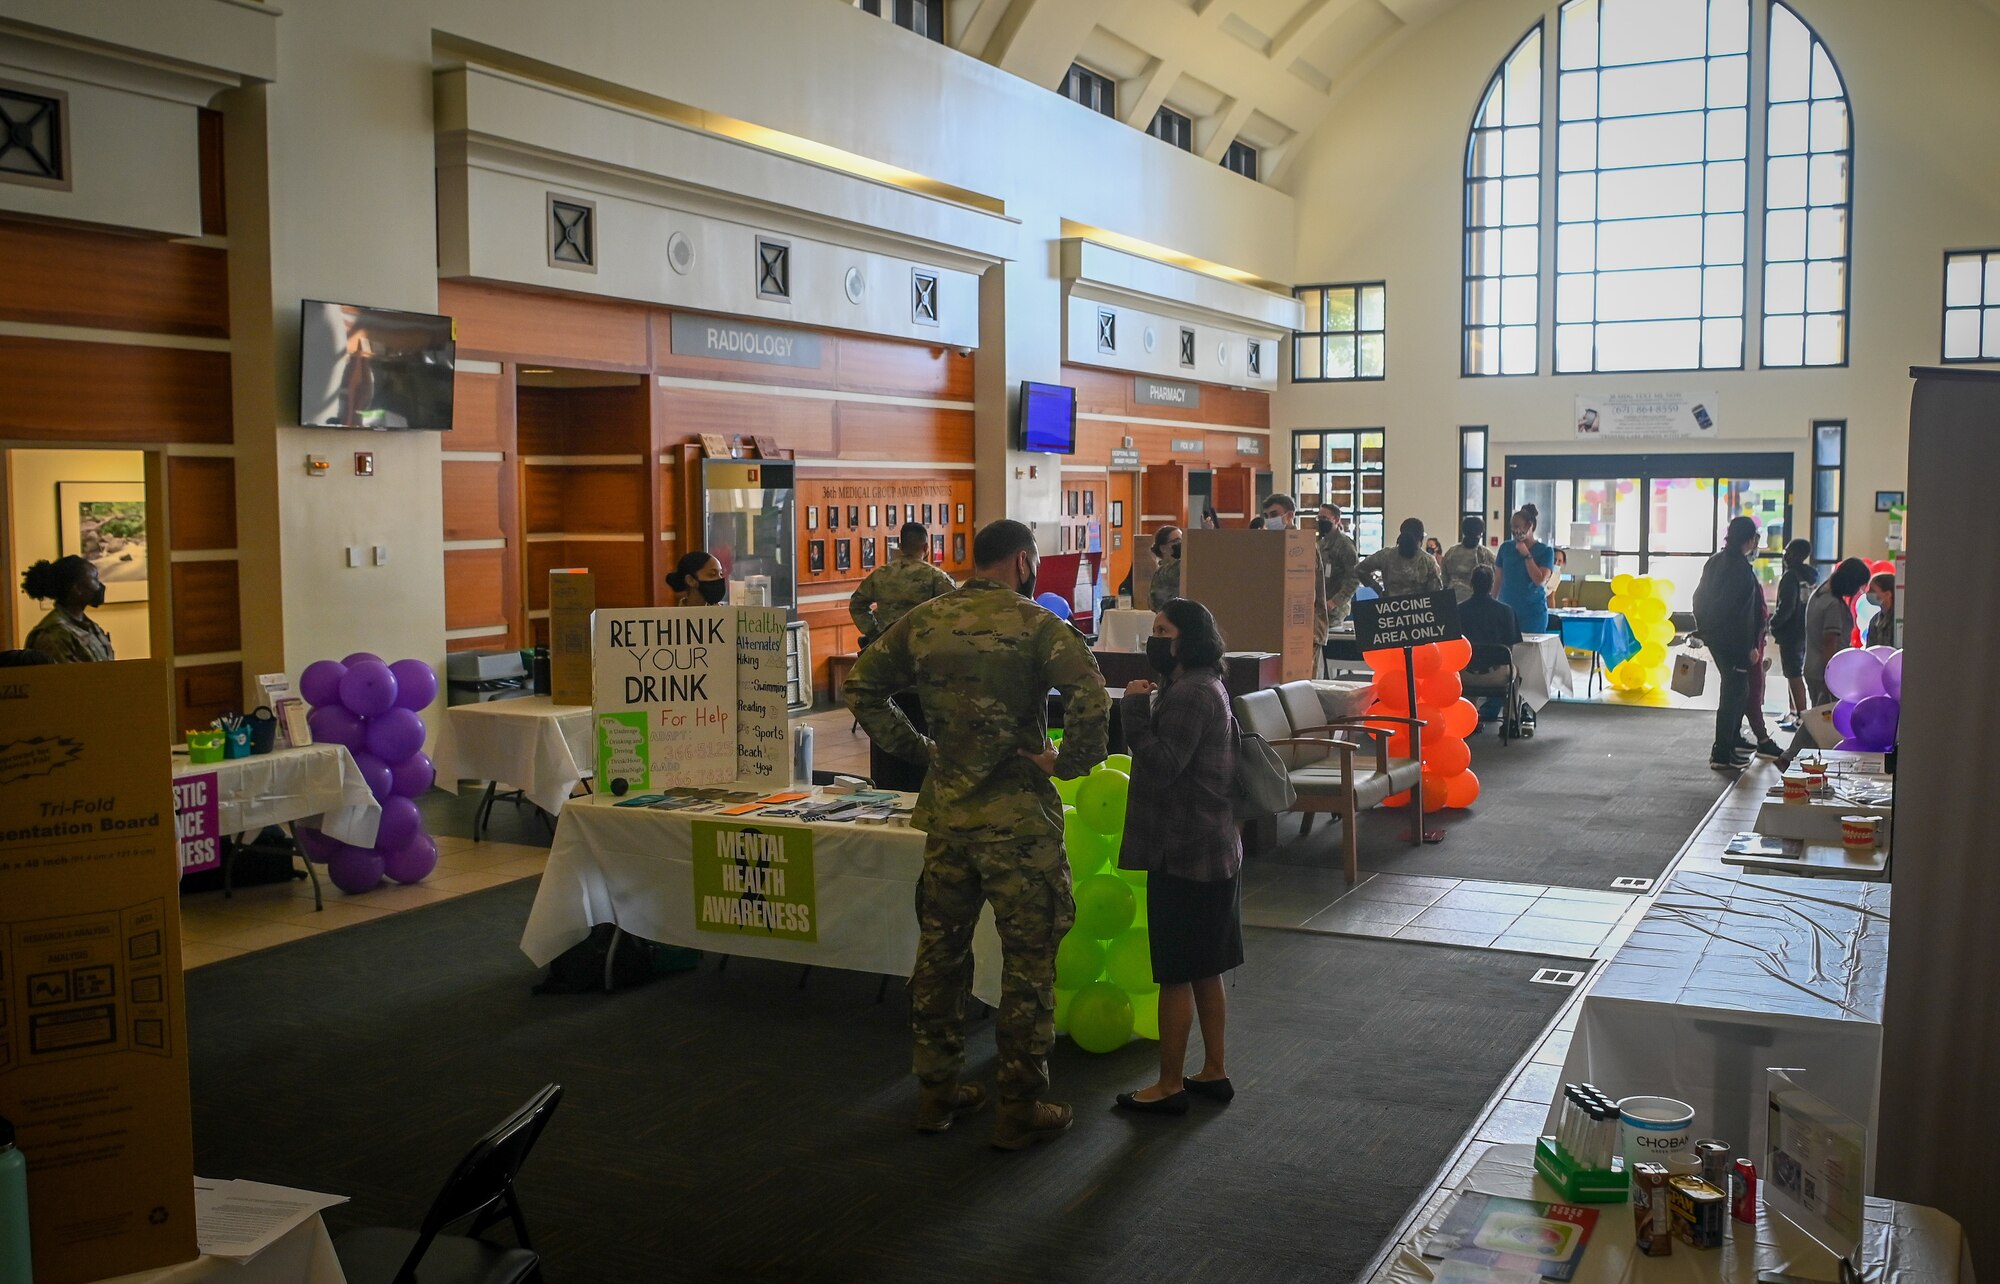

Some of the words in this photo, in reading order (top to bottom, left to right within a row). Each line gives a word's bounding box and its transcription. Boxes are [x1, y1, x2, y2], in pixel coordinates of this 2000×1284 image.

[707, 328, 794, 356] RADIOLOGY
[1150, 385, 1186, 402] PHARMACY
[822, 486, 838, 498] 36th
[838, 486, 870, 498] MEDICAL
[872, 486, 896, 498] GROUP
[898, 486, 921, 497] AWARD
[1375, 597, 1432, 615] VACCINE
[737, 610, 786, 641] Healthy
[1378, 611, 1435, 629] SEATING
[610, 618, 725, 648] RETHINK
[1373, 630, 1408, 645] AREA
[1411, 625, 1446, 640] ONLY
[736, 636, 780, 651] Alternates
[628, 647, 709, 672] YOUR
[737, 653, 759, 670] Hiking
[625, 673, 708, 704] DRINK
[754, 679, 787, 699] Swimming
[737, 700, 766, 718] Reading
[661, 709, 687, 727] For
[696, 705, 729, 734] Help
[754, 725, 784, 742] Sports
[737, 744, 762, 759] Beach
[755, 763, 773, 776] Yoga
[39, 796, 116, 819] Tri-Fold
[100, 812, 160, 833] Board
[716, 830, 789, 863] MENTAL
[722, 863, 786, 897] HEALTH
[702, 895, 810, 933] AWARENESS
